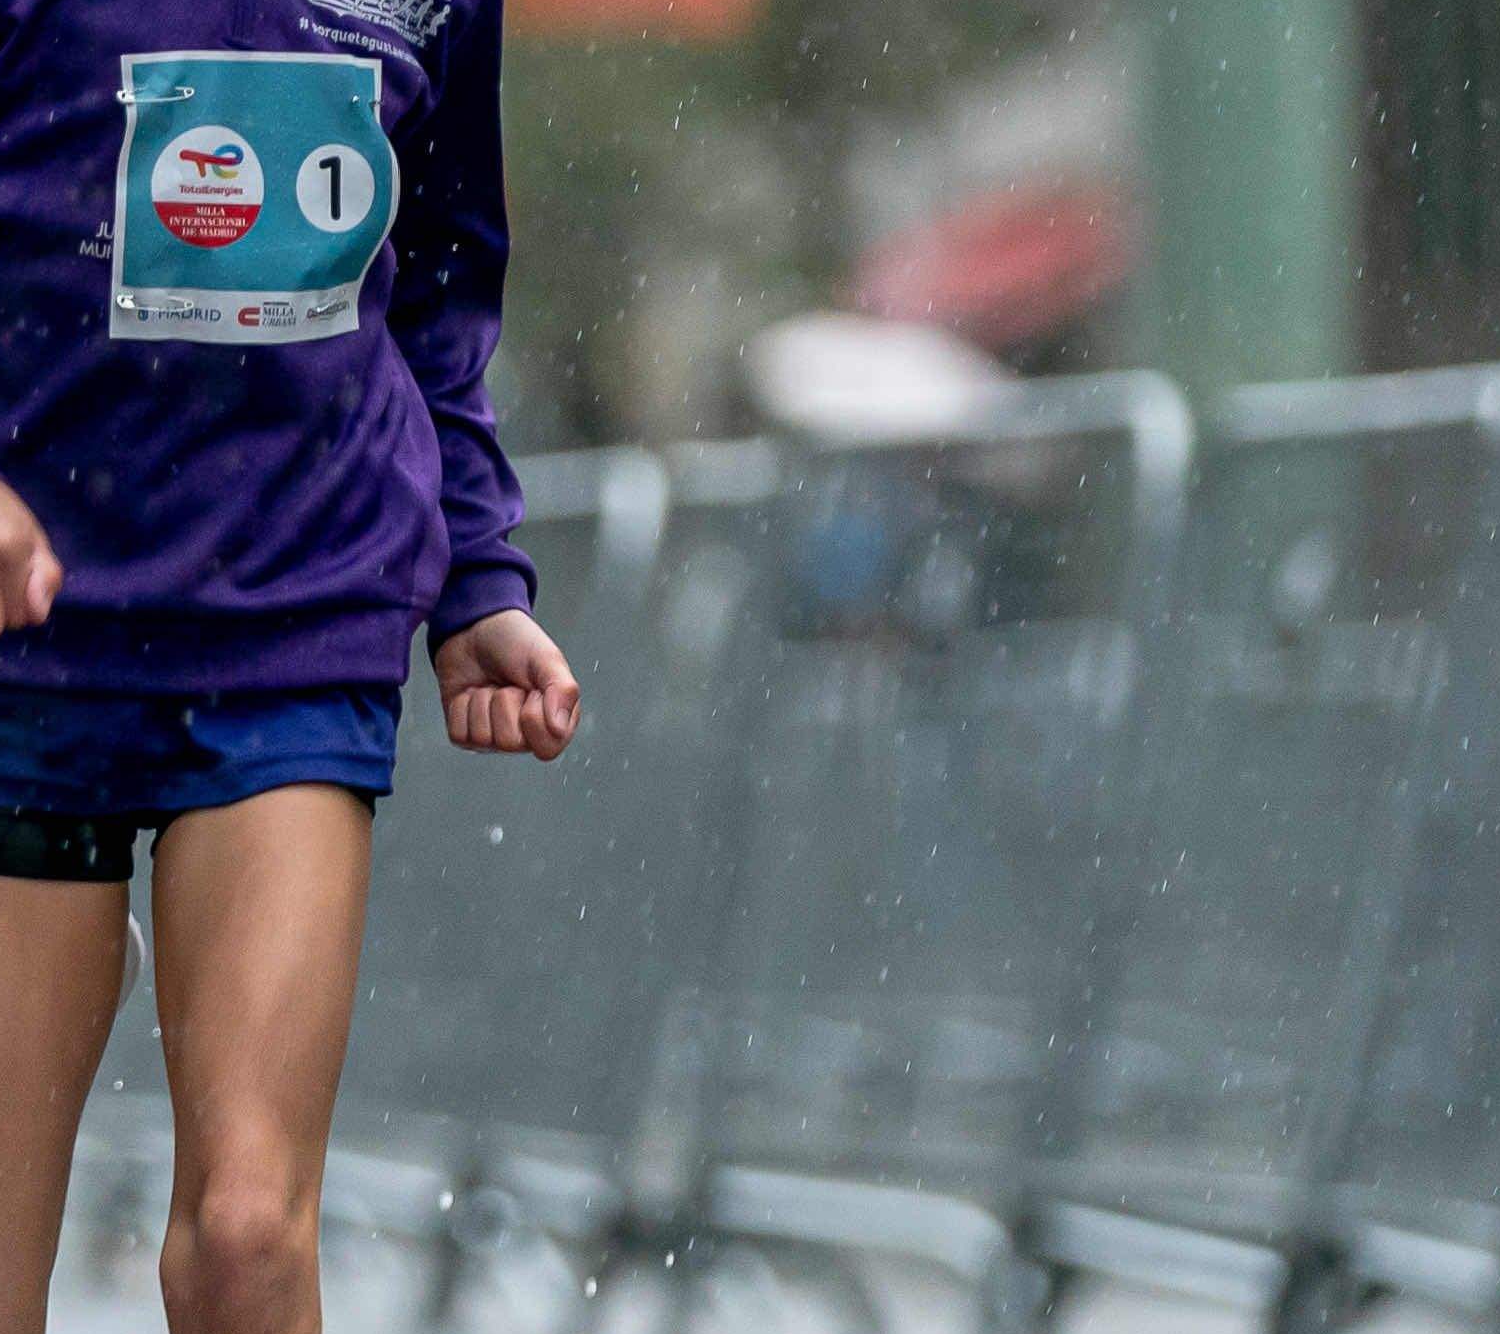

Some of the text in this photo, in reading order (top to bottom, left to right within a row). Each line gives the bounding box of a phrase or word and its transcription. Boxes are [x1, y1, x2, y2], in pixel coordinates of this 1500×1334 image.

[180, 185, 243, 196] TotalEnergies
[319, 156, 341, 220] 1
[196, 206, 225, 216] MILLA
[169, 217, 247, 227] INTERNACIONAL
[182, 227, 237, 237] DE MADRID
